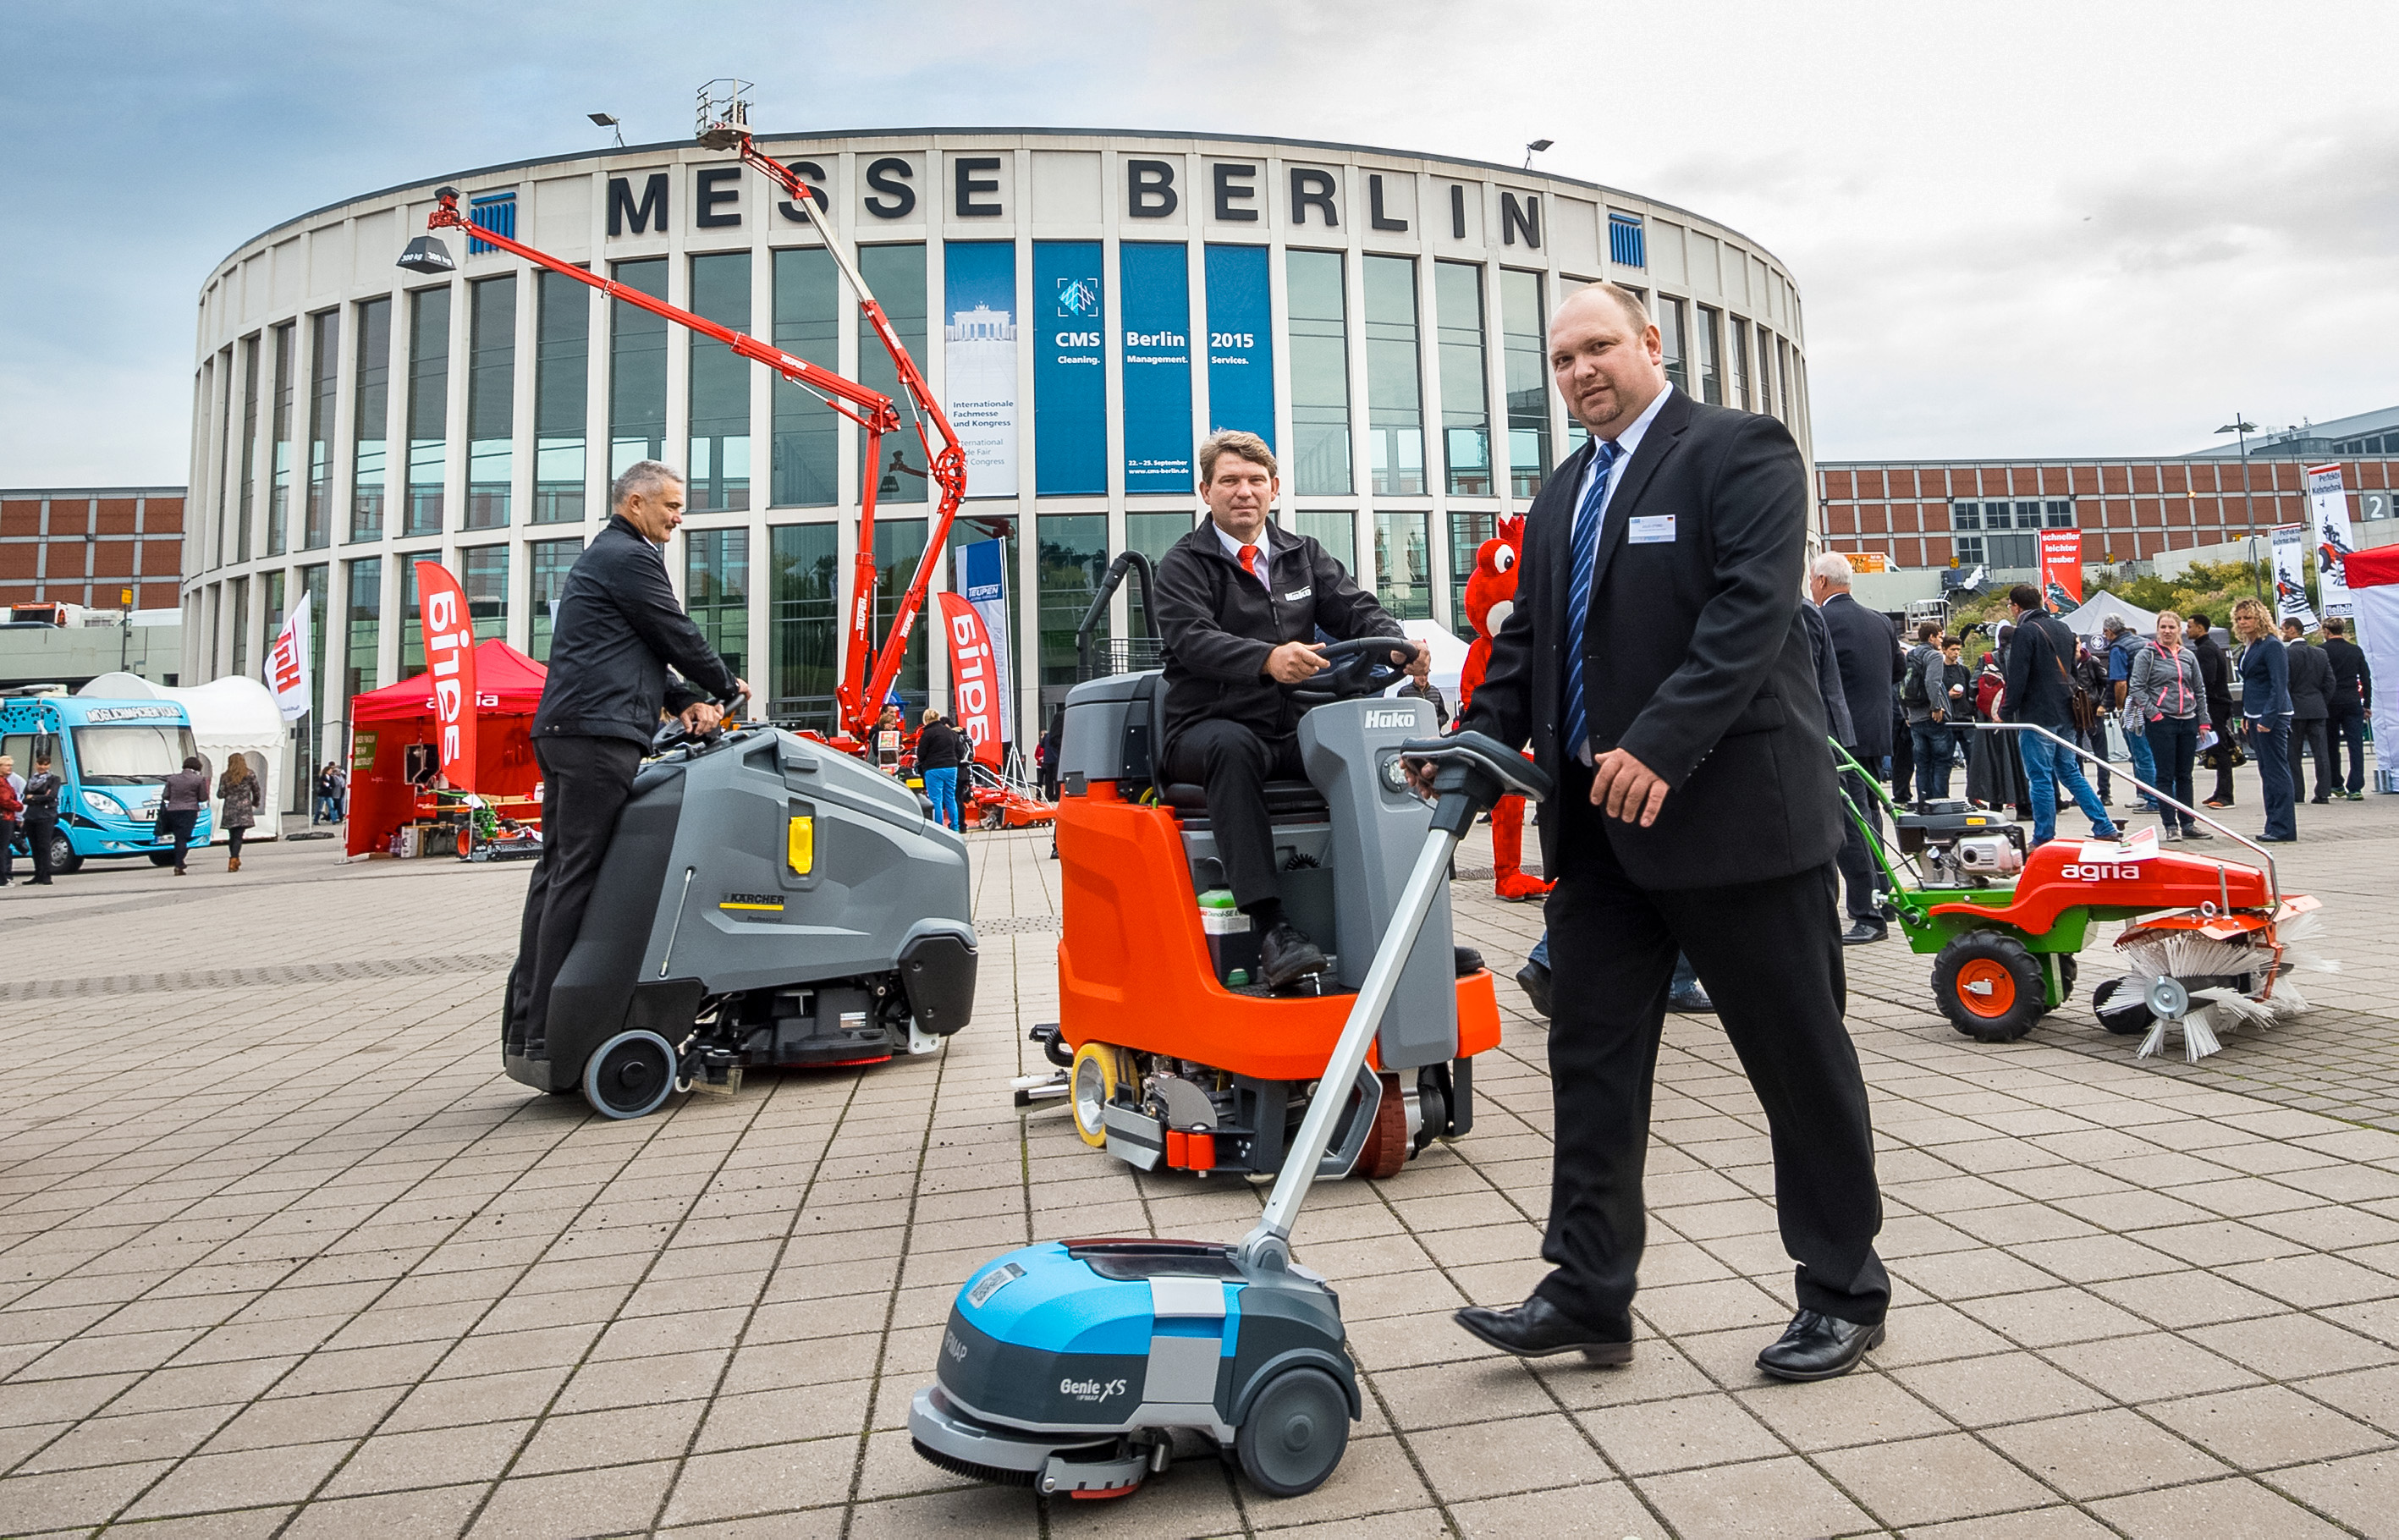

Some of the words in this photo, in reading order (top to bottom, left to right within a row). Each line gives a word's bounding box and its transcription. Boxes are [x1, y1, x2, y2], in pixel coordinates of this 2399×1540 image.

[608, 157, 1003, 236] MESSE
[1127, 159, 1541, 249] BERLIN
[1055, 332, 1101, 347] CMS
[1126, 331, 1186, 347] Berlin
[1211, 333, 1254, 348] 2015
[1057, 355, 1101, 365] Cleaning.
[1126, 355, 1188, 364] Management.
[1211, 355, 1249, 365] Services.
[953, 399, 1014, 408] Internationale
[972, 420, 1011, 428] Kongress
[960, 438, 1004, 447] ternational
[970, 458, 1005, 467] Congress
[2369, 496, 2385, 519] 2
[2042, 532, 2081, 542] schneller
[2044, 544, 2078, 553] leichter
[2046, 555, 2076, 564] sauber
[968, 584, 999, 597] TEUPEN
[426, 690, 499, 710] aia
[1365, 709, 1416, 729] Hako
[2061, 862, 2140, 882] agria
[730, 893, 785, 905] KÄRCHER
[1059, 1378, 1101, 1394] Genie
